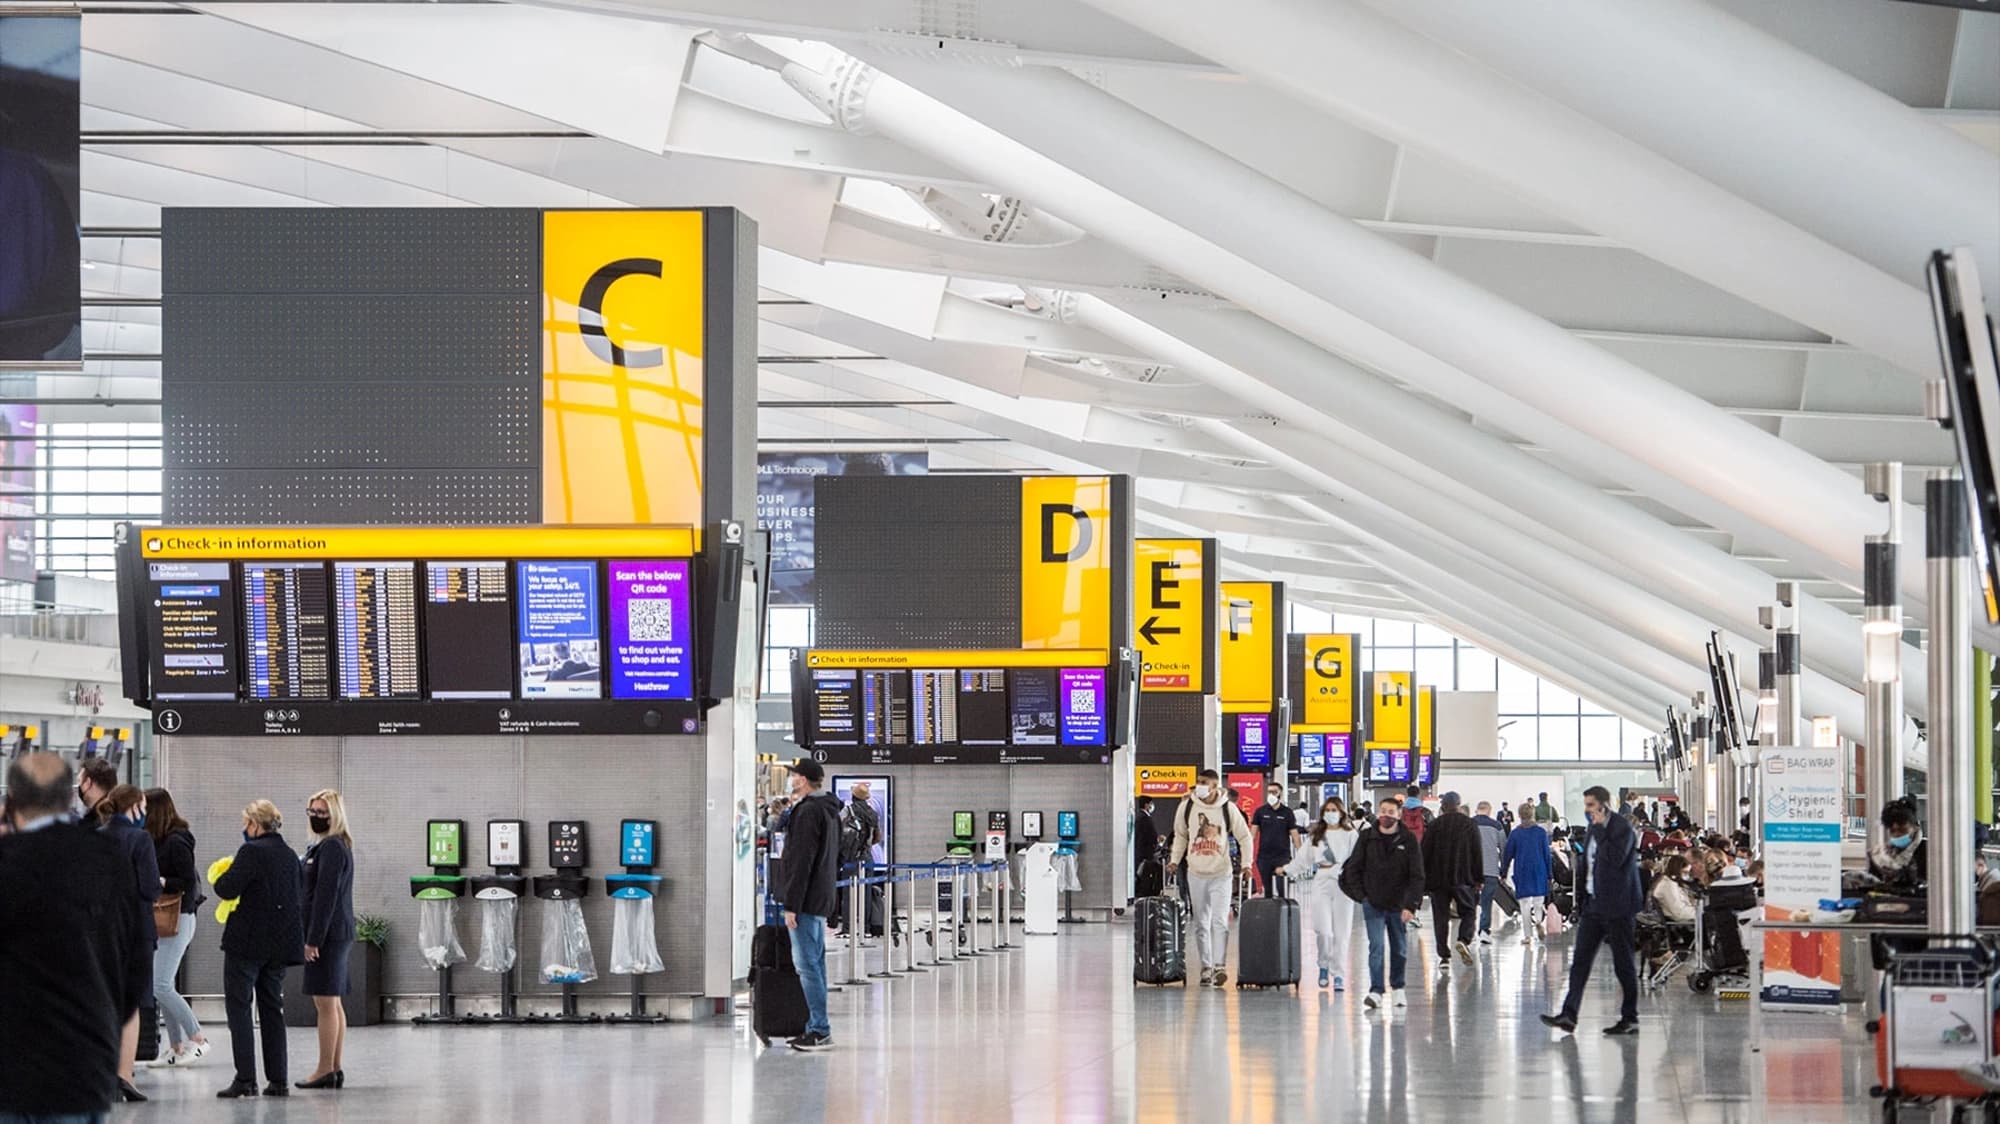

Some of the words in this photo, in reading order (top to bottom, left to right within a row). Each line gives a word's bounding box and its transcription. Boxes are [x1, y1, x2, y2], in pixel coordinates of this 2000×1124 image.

[578, 258, 663, 368] C
[774, 464, 828, 476] Technologies
[758, 520, 793, 529] EVER
[772, 532, 796, 542] PS.
[1041, 504, 1092, 563] D
[167, 537, 233, 550] Check-in
[237, 537, 328, 550] information
[616, 571, 637, 581] Scan
[638, 571, 653, 581] the
[654, 571, 682, 581] below
[631, 584, 645, 594] QR
[646, 584, 667, 594] code
[1152, 562, 1181, 609] E
[1230, 601, 1253, 641] F
[619, 647, 628, 655] to
[629, 646, 644, 655] find
[645, 647, 658, 655] out
[659, 646, 683, 655] where
[622, 656, 631, 664] to
[632, 656, 649, 666] shop
[650, 656, 665, 664] and
[821, 656, 857, 664] Check-in
[858, 656, 908, 664] information
[1314, 647, 1342, 678] G
[1154, 661, 1190, 670] Check-in
[634, 682, 670, 691] Heathrow
[1382, 682, 1402, 706] H
[1787, 758, 1807, 768] BAG
[1808, 758, 1836, 768] WRAP
[1152, 770, 1188, 778] Check-in
[1789, 795, 1836, 807] Hygienic
[1789, 808, 1824, 819] Shield
